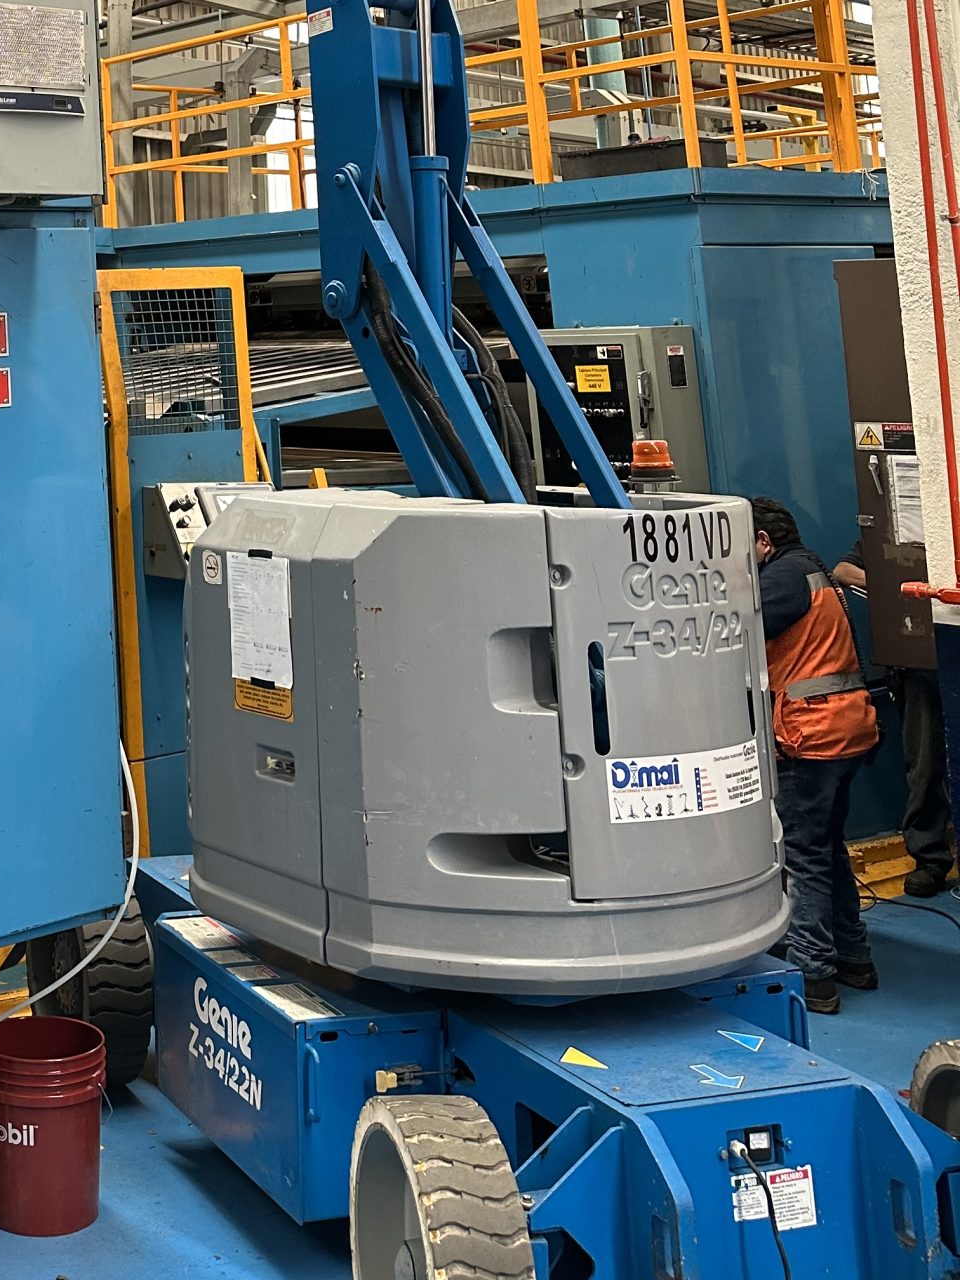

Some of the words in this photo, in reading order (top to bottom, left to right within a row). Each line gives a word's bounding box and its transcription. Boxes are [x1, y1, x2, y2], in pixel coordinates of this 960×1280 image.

[621, 560, 728, 611] Genie
[607, 611, 743, 660] Z-34/22
[612, 757, 680, 788] Dimai
[193, 976, 252, 1060] Genie
[188, 1022, 263, 1111] Z-34/22N
